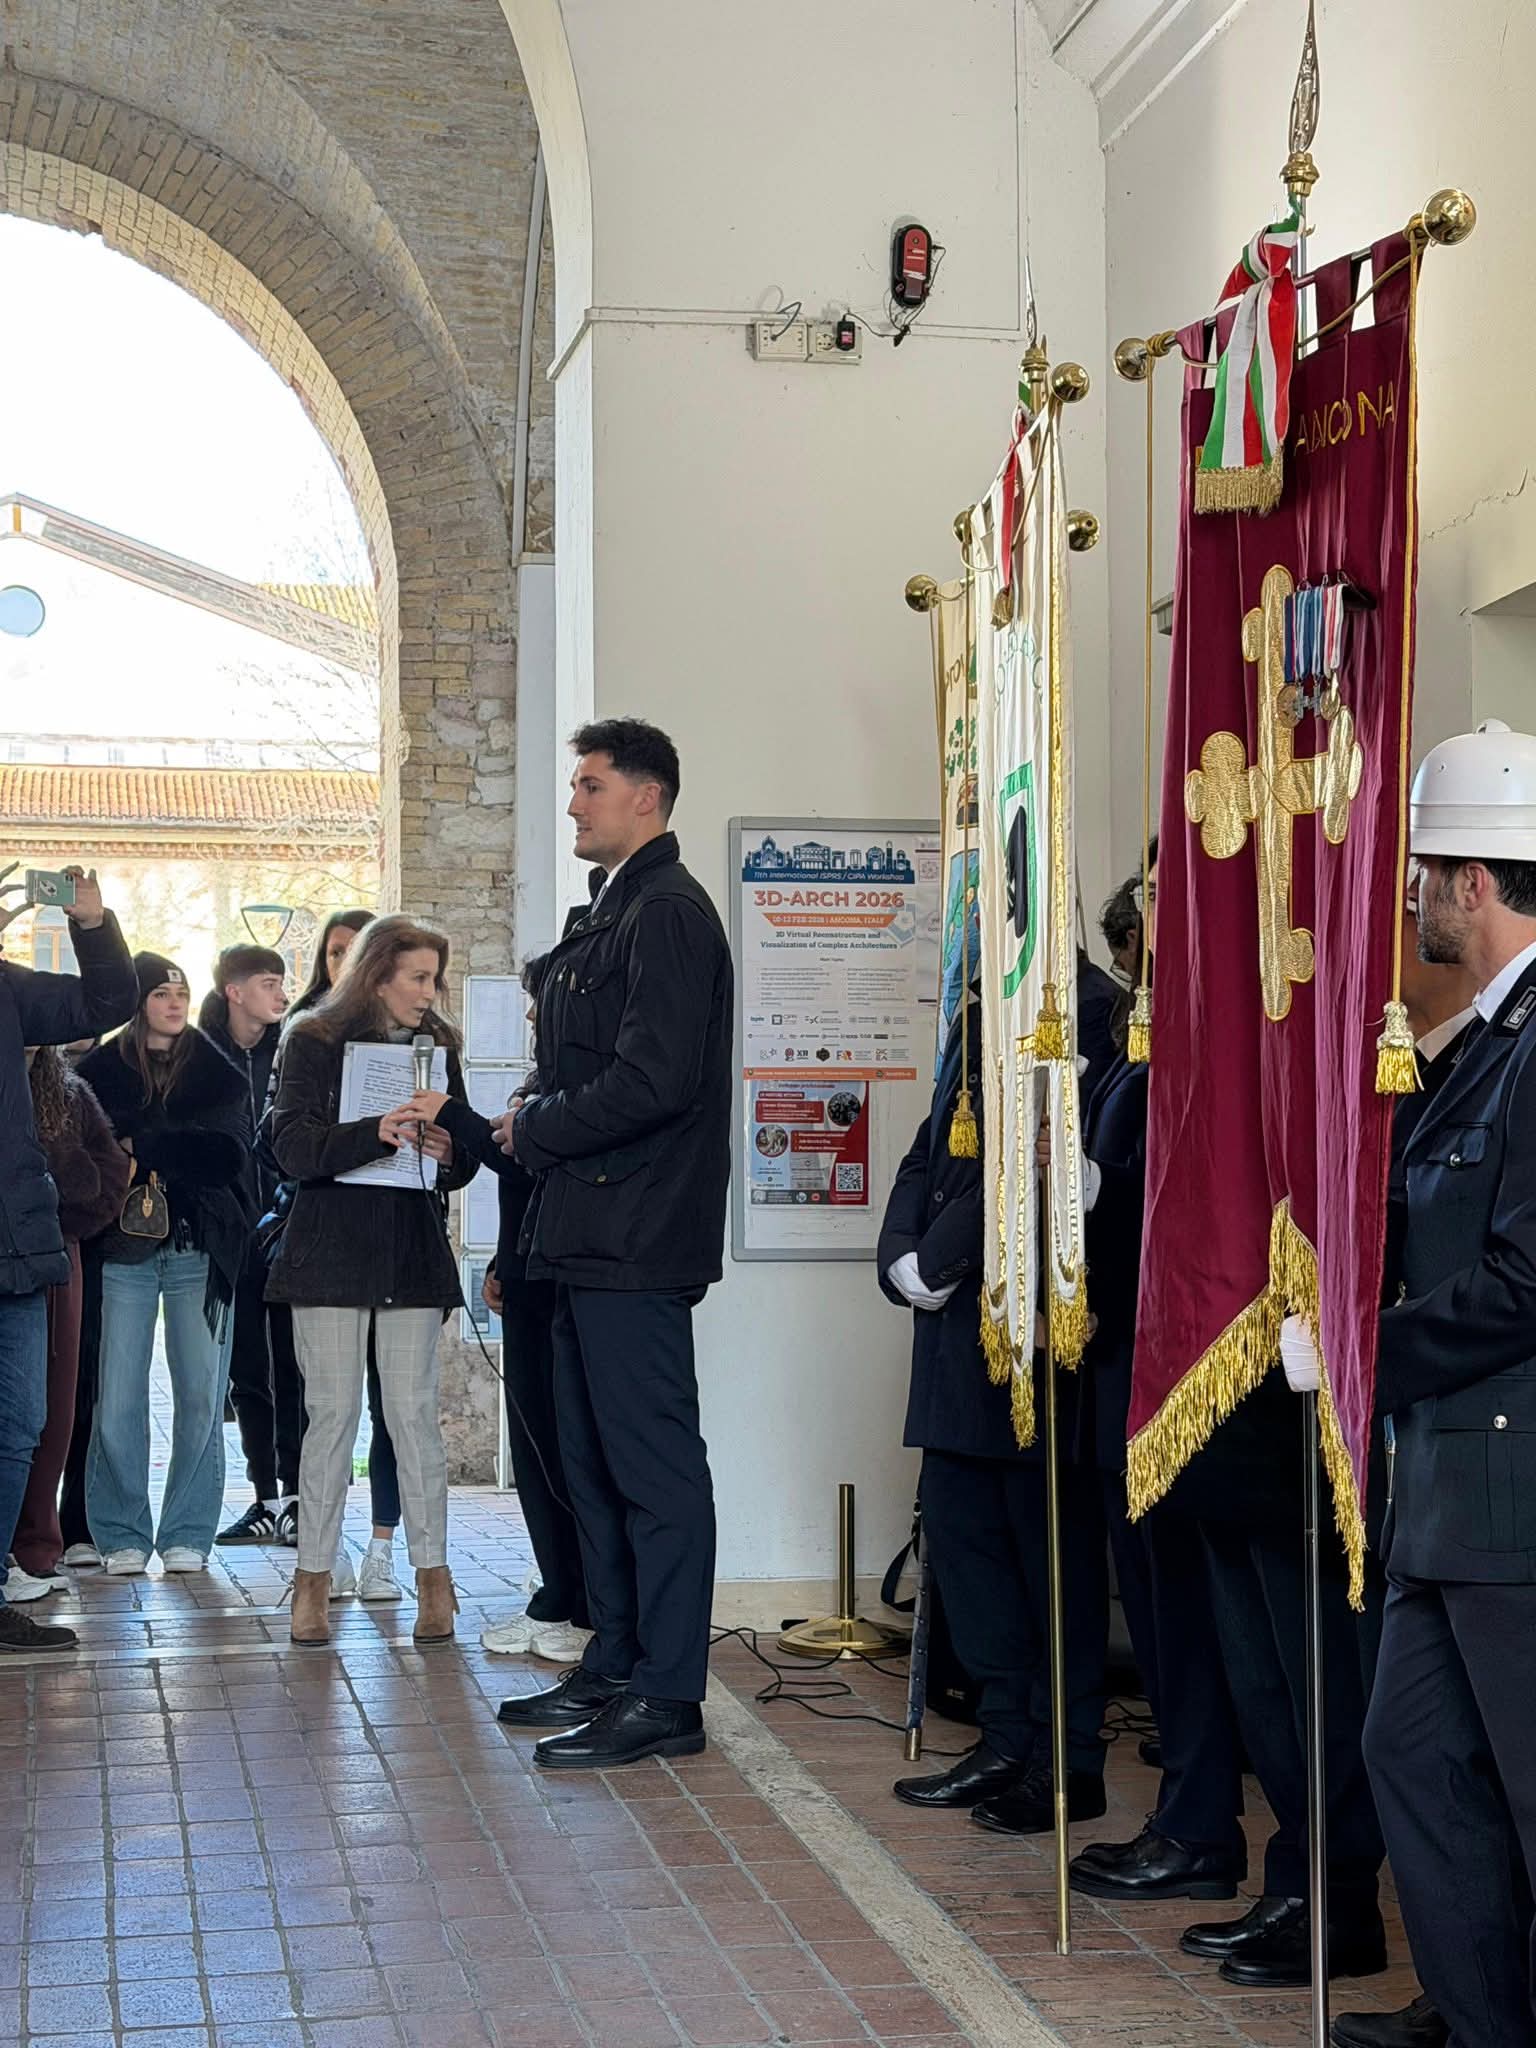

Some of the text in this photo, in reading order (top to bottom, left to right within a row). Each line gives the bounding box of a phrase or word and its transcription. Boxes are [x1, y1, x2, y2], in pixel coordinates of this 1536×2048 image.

[769, 870, 817, 880] International
[847, 871, 866, 880] CIPA
[867, 872, 905, 881] Workshop
[753, 890, 905, 908] 3D-ARCH 2026
[864, 917, 885, 925] ITALY
[786, 931, 811, 939] Virtual
[812, 931, 866, 939] Reconstruction
[867, 931, 881, 939] and
[760, 941, 897, 950] Visualization of Complex Architectures
